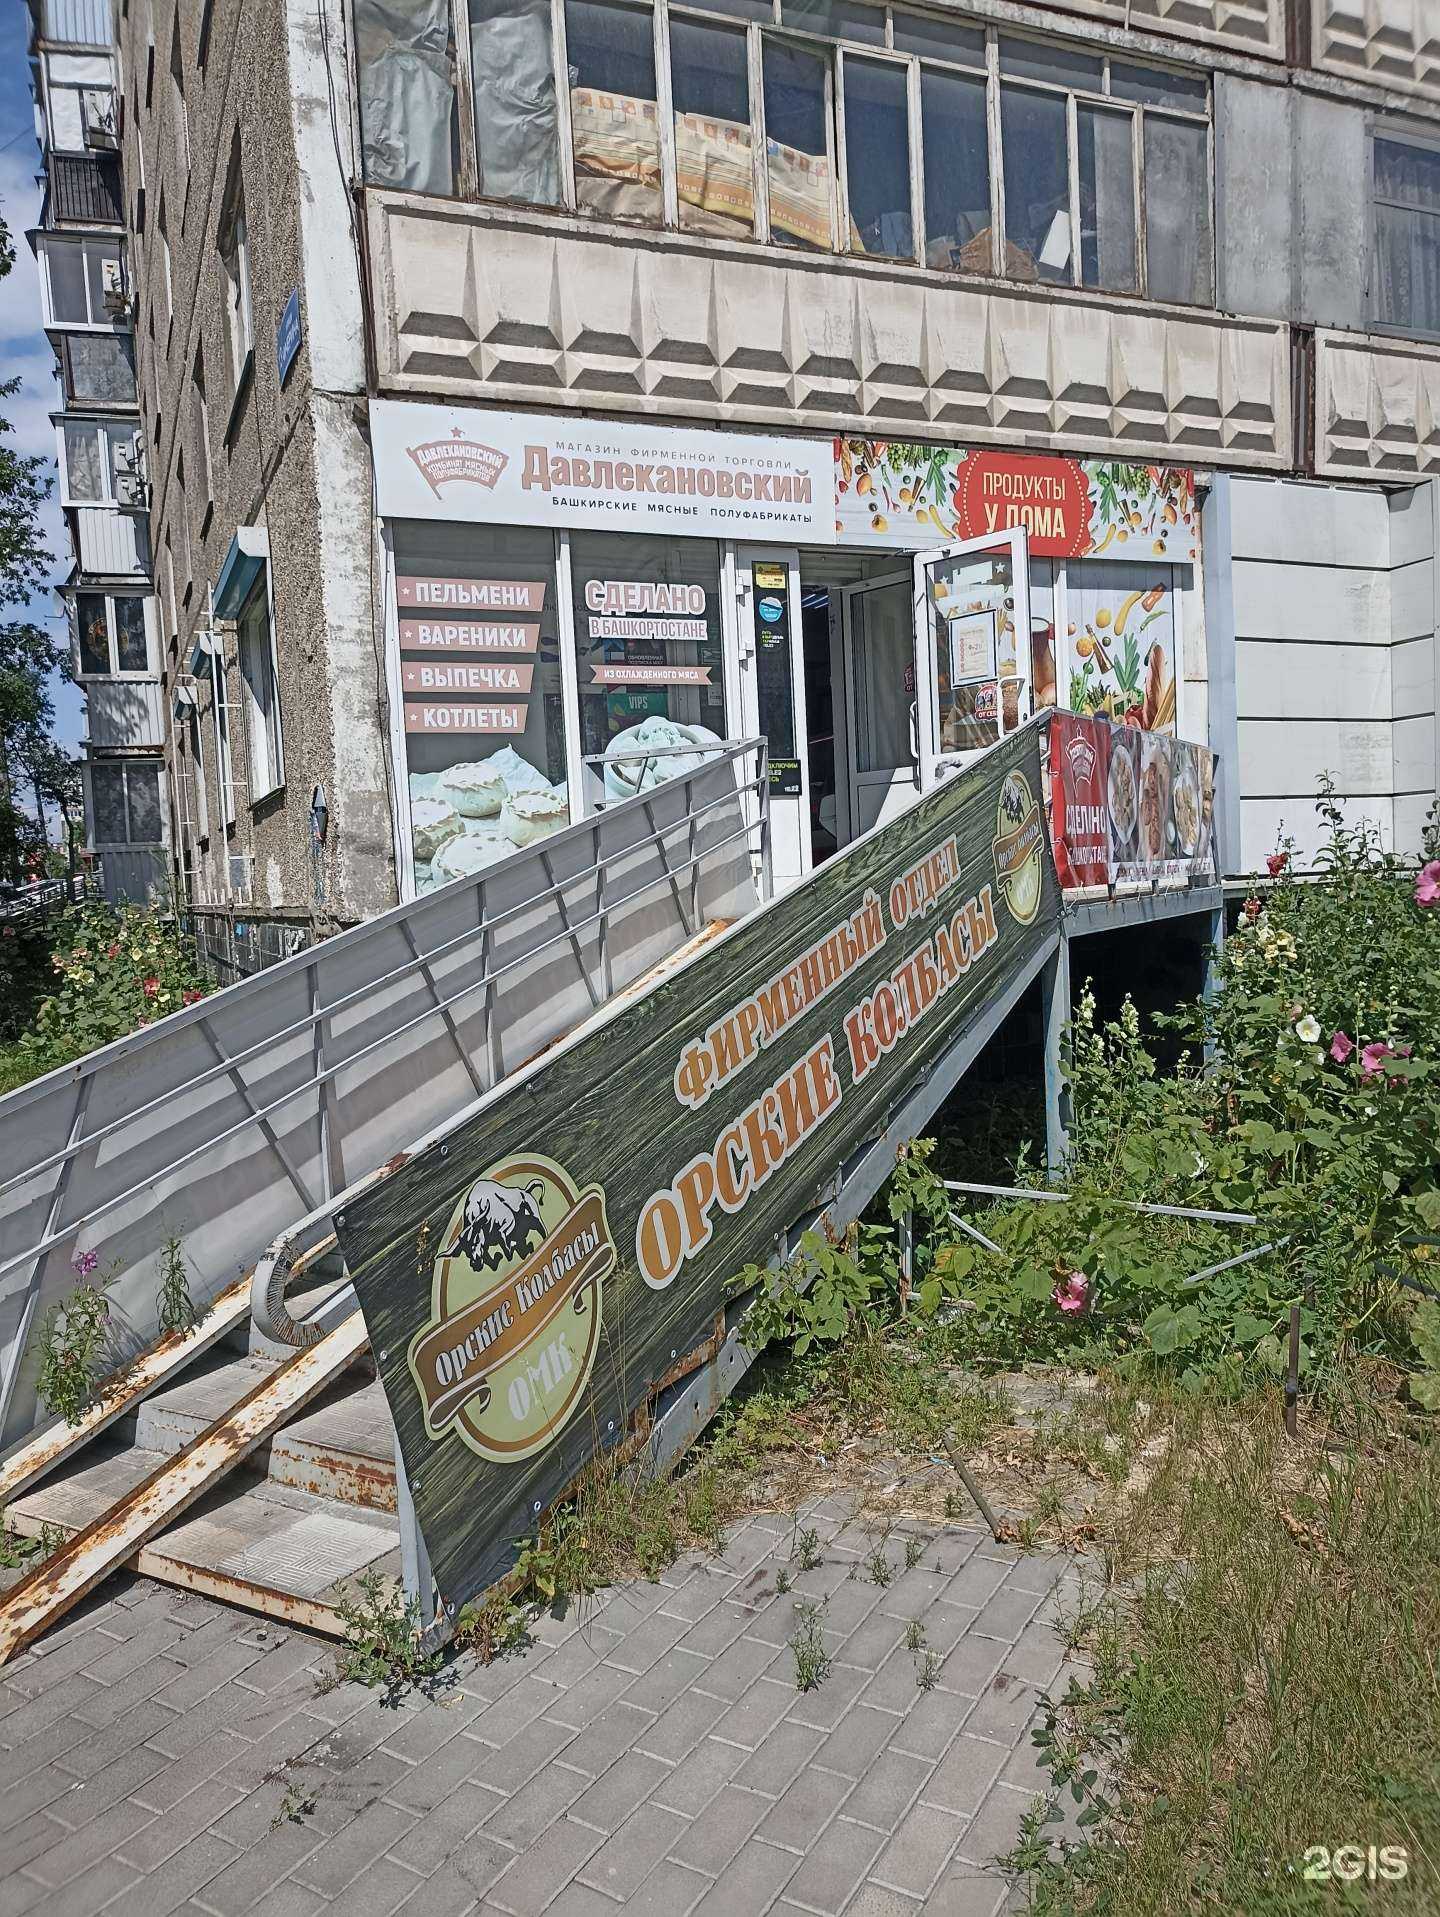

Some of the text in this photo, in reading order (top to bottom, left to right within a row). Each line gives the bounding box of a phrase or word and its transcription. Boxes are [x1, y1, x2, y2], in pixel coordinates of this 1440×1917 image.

[555, 440, 792, 470] МАГАЗИН ФИРМЕННОЙ ТОРГОВЛИ
[522, 445, 813, 504] Давлекановский
[982, 471, 1067, 501] ПРОДУКТЫ
[552, 496, 813, 523] БАШКИРСКИЕ МЯСНЫЕ ПОЛУФАБРИКАТЫ
[984, 502, 1000, 534] У
[415, 582, 529, 606] ПЕЛЬМЕНИ
[586, 580, 705, 614] СДЕЛАНО
[418, 625, 527, 647] ВАРЕНИКИ
[591, 619, 706, 638] В БАШКОРТОСТАНЕ
[421, 667, 520, 688] ВЫПЕЧКА
[604, 670, 699, 679] ИЗ ОХЛАЖДЕННОГО МЯСА
[628, 695, 648, 709] VIPS
[423, 707, 518, 729] КОТЛЕТЫ
[677, 838, 960, 1104] ФИРМЕННЫЙ ОТДЕЛ
[639, 889, 997, 1281] ОРСКИЕ КОЛБАСЫ
[434, 1221, 601, 1387] Орские Колбасы
[507, 1332, 574, 1421] ОМК
